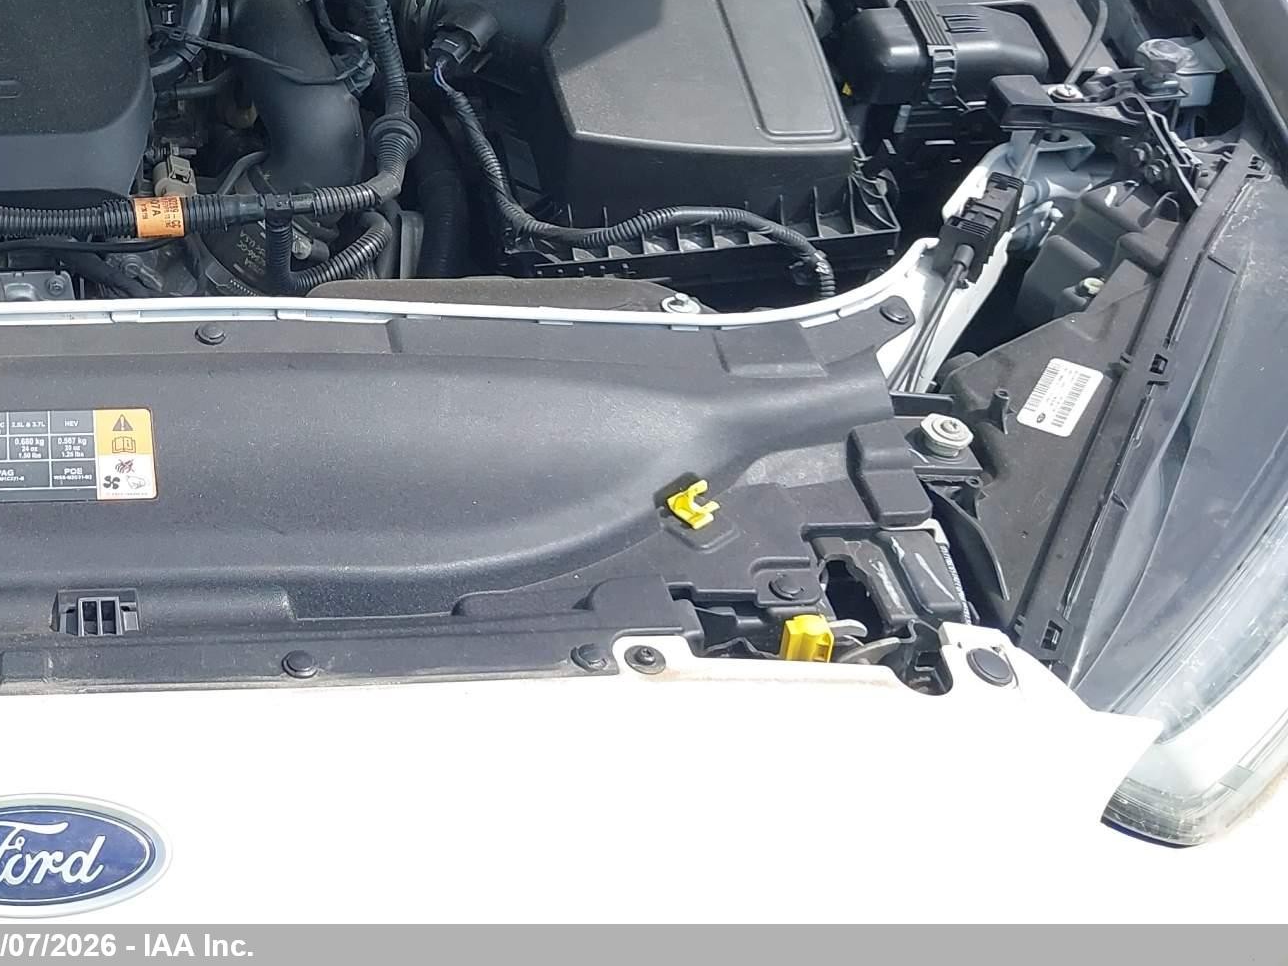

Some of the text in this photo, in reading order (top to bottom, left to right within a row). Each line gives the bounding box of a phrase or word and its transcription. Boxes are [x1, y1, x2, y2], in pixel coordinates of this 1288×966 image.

[14, 437, 45, 447] 0.680 kg
[78, 437, 87, 446] kg
